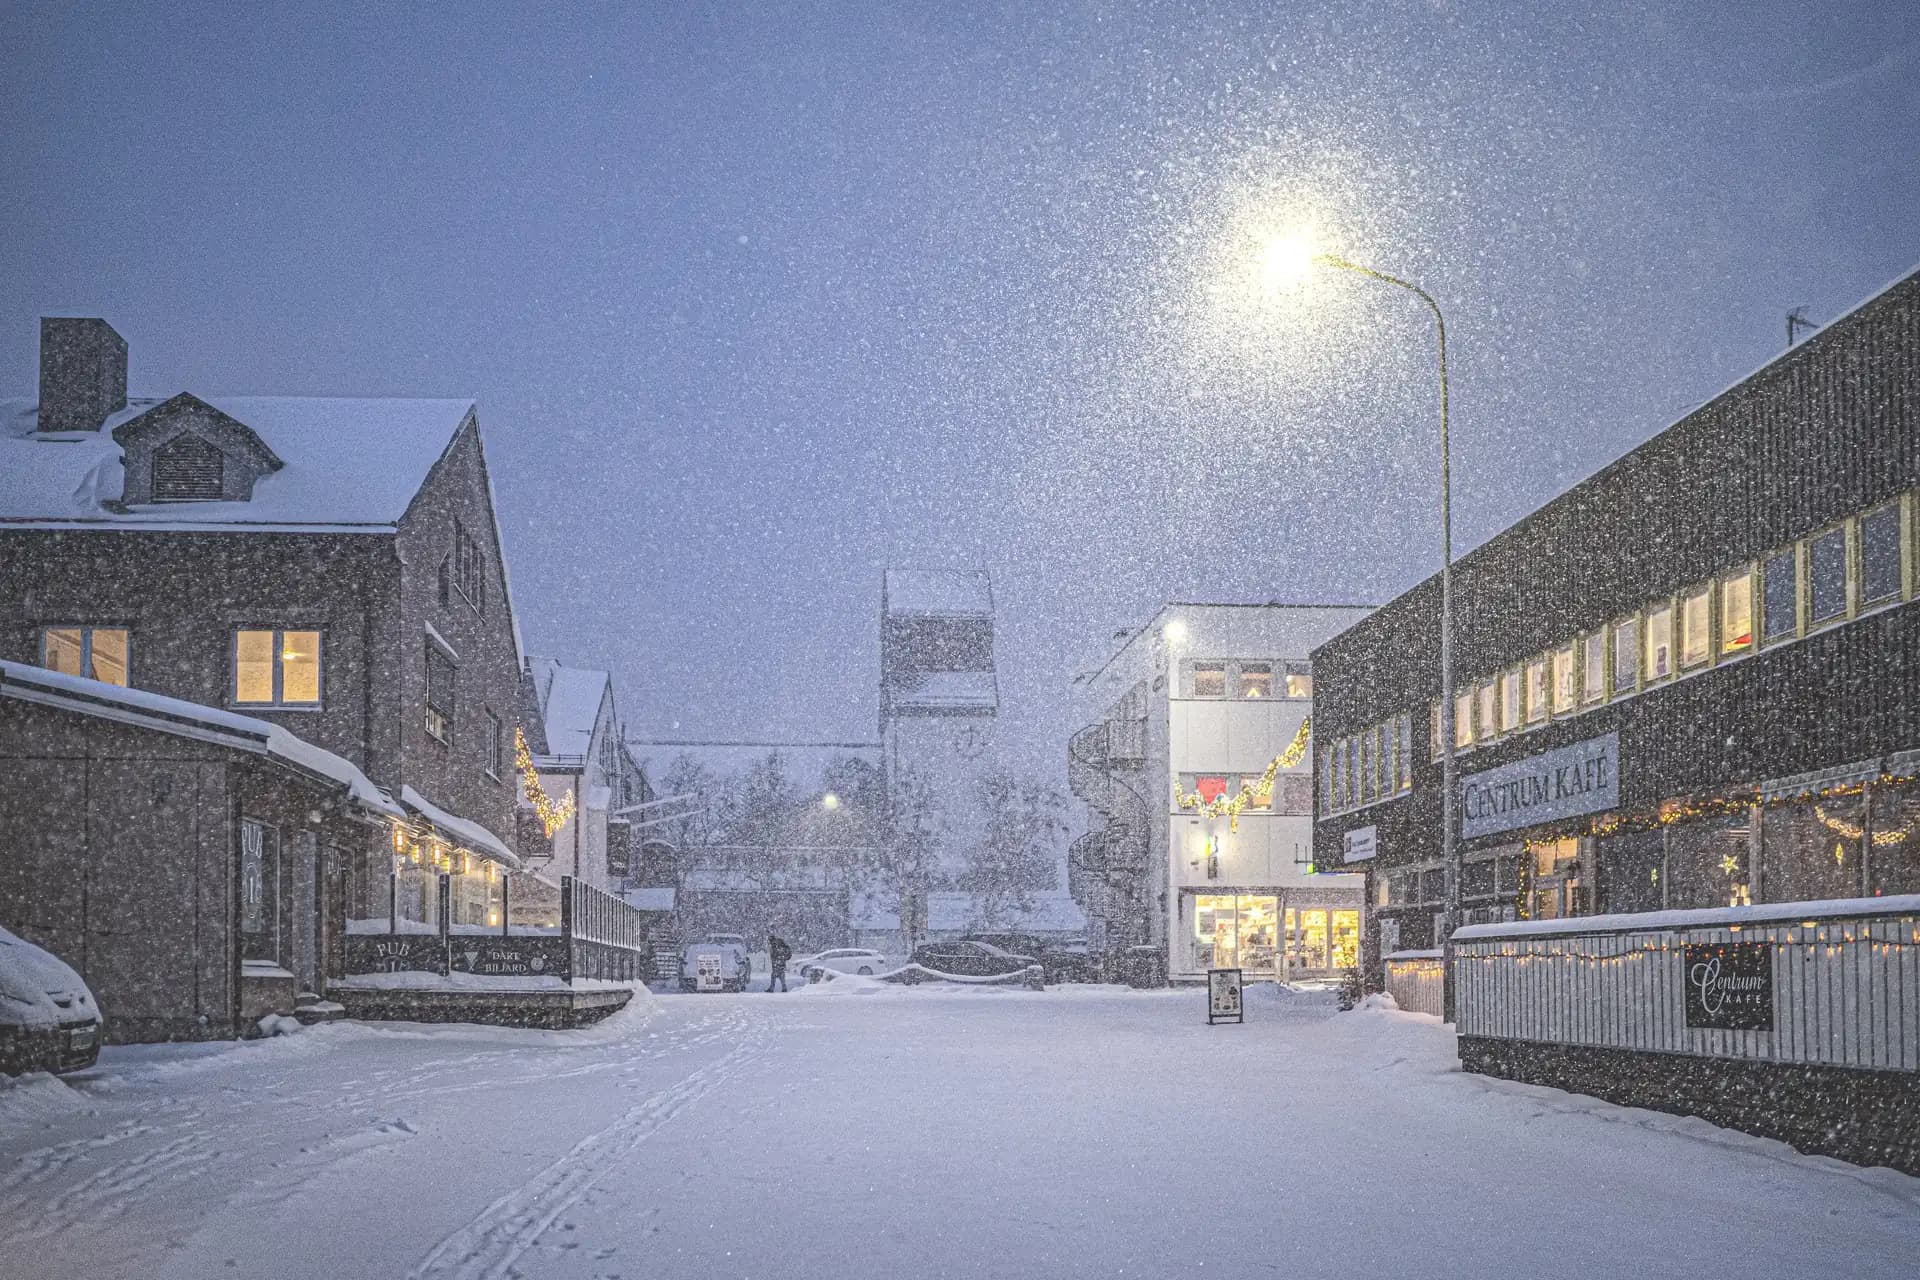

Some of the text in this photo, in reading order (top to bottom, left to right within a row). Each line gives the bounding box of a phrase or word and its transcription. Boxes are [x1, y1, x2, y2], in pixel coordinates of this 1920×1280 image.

[1464, 747, 1607, 820] CENTRUM KAFÉ
[242, 824, 263, 859] PUB
[377, 942, 409, 956] PUB
[492, 951, 520, 961] DART
[485, 963, 527, 973] BILJARD
[1691, 957, 1763, 1013] Centrum
[1726, 994, 1761, 1004] KAFE
